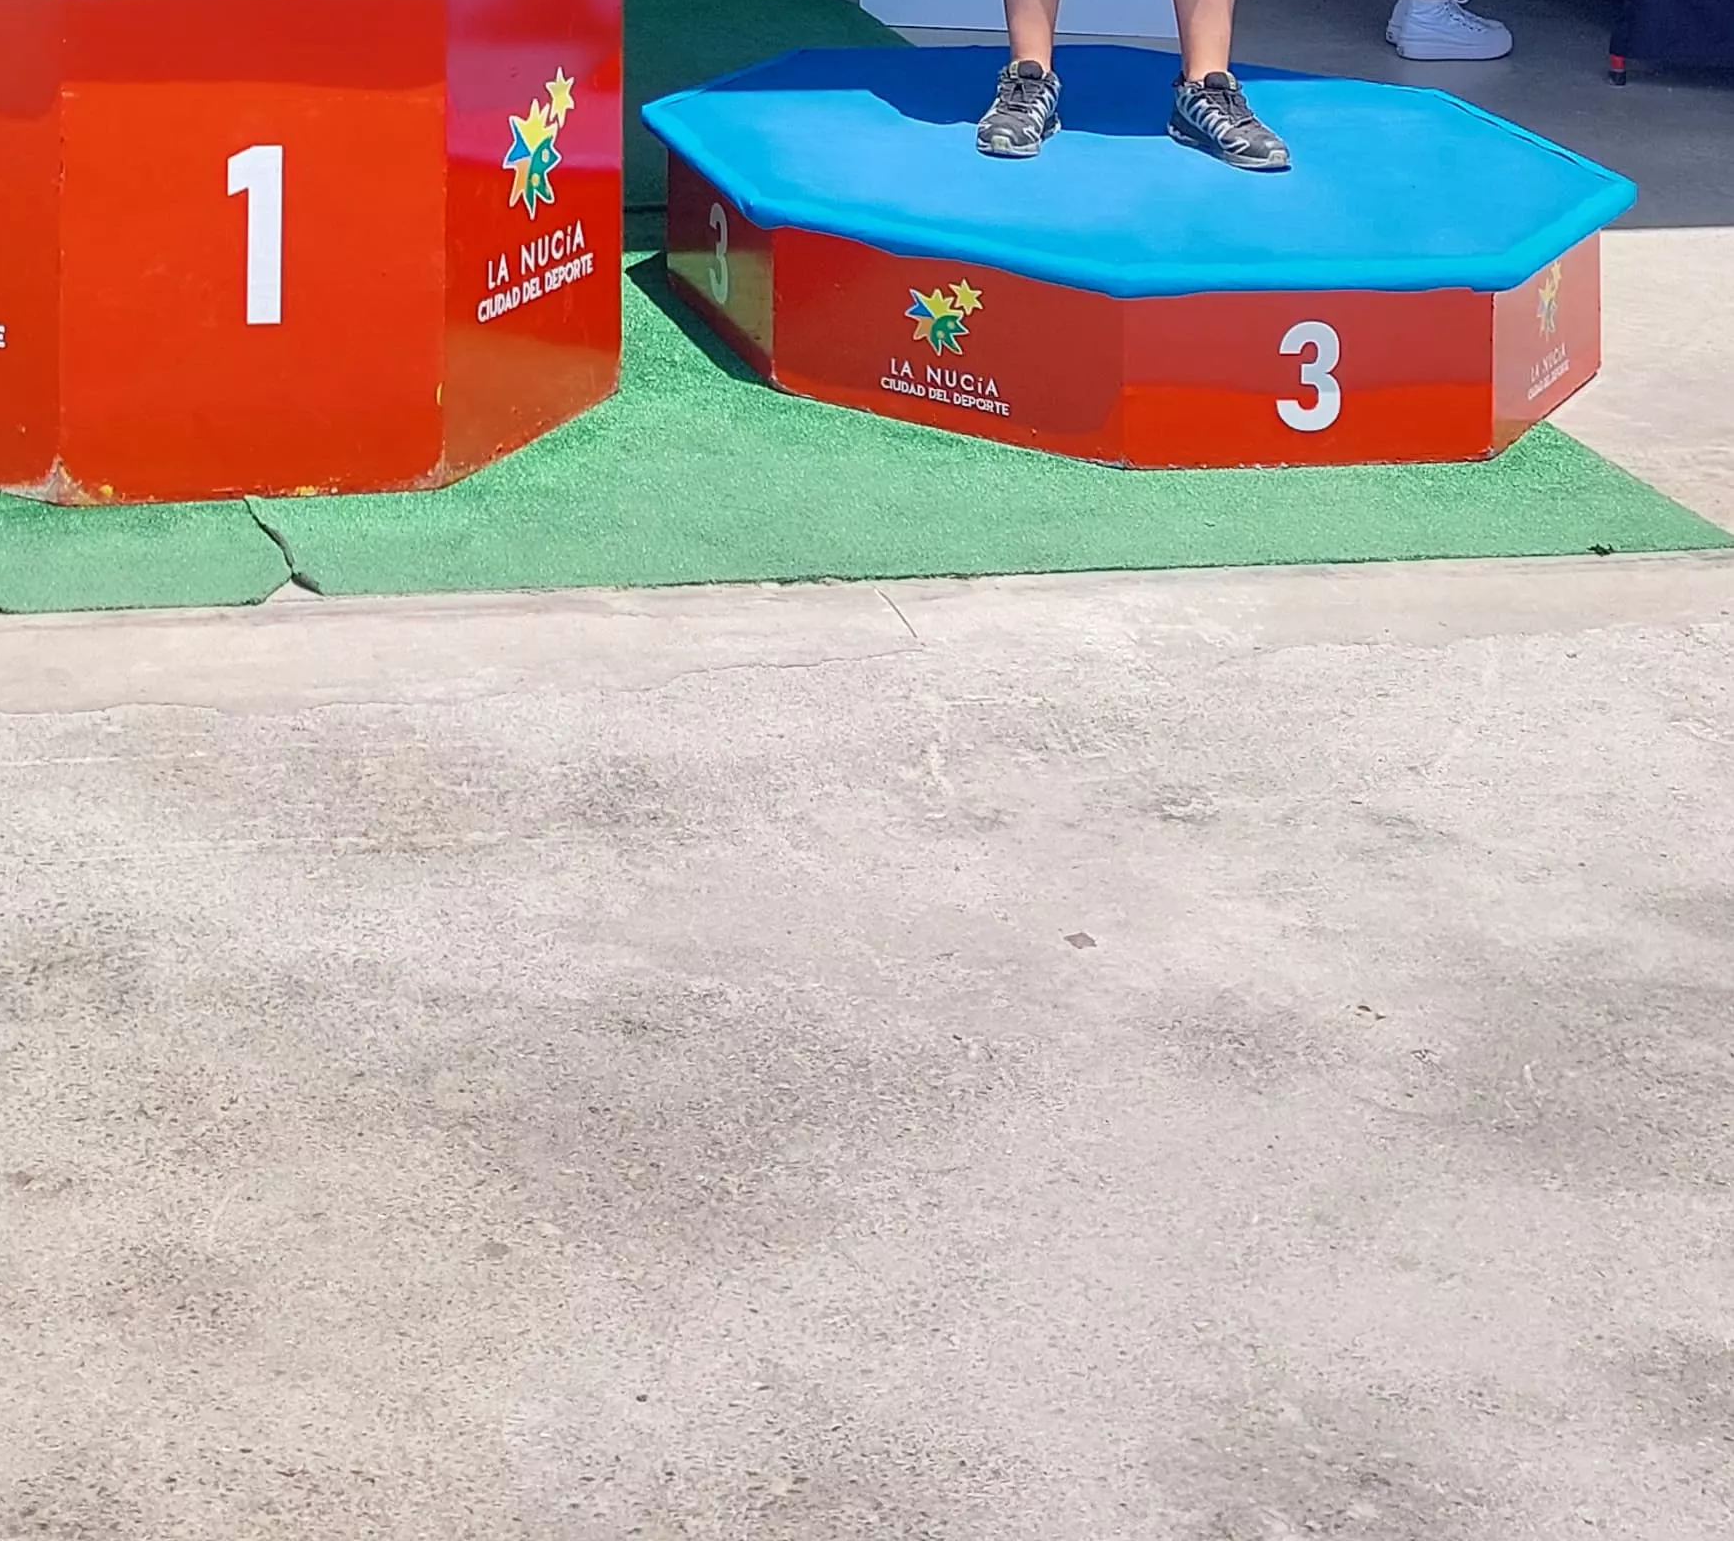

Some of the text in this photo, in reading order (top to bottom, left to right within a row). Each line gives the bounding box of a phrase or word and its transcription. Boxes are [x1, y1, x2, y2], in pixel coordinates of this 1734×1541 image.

[227, 145, 283, 325] 1
[709, 202, 729, 305] 3
[477, 252, 593, 322] CIUDAD DEL DEPORTE
[488, 253, 509, 290] LA
[880, 377, 1010, 416] CIUDAD DEL DEPORTE
[891, 357, 914, 379] LA
[1277, 322, 1340, 433] 3
